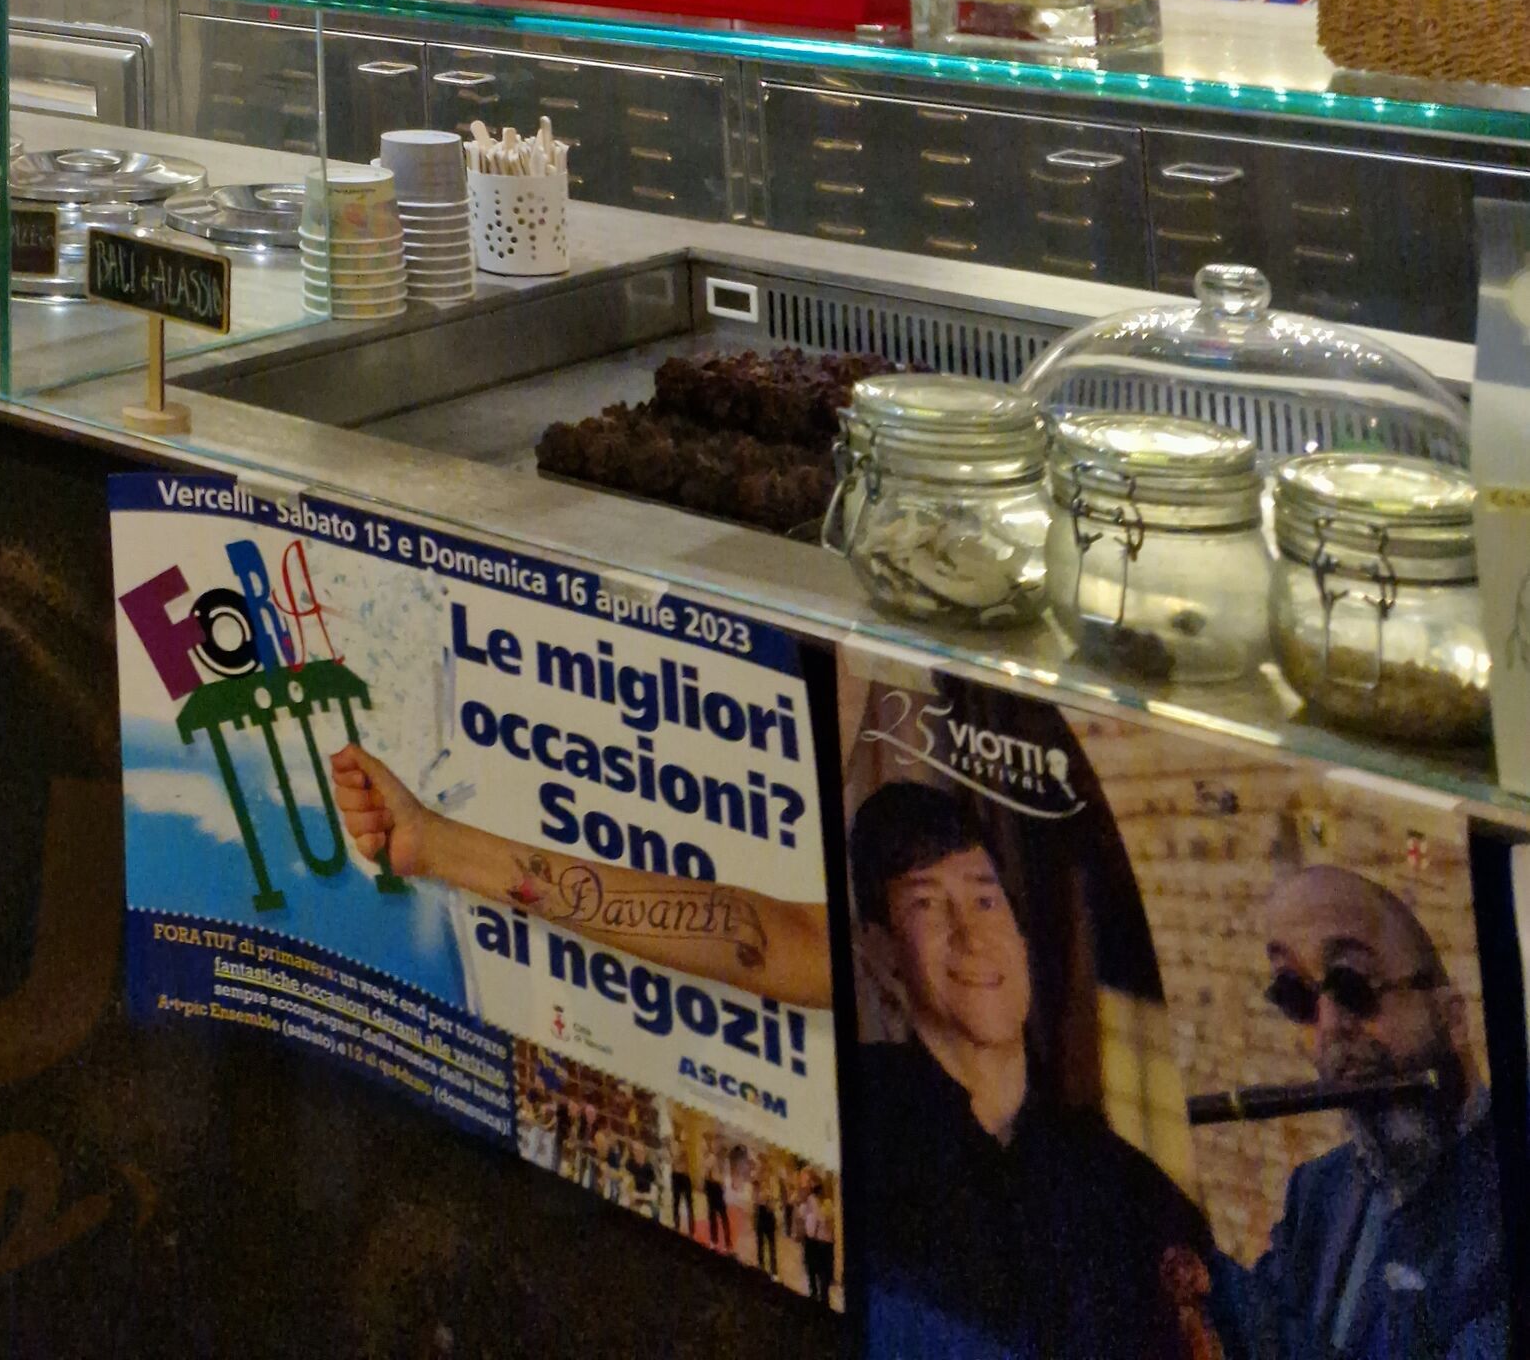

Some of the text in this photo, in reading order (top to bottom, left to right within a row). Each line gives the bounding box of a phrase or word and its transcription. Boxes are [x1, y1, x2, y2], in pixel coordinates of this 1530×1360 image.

[157, 479, 754, 655] Vercelli Sabato 15 e Domenica 16 aprile 2023
[449, 603, 799, 763] Le migliori
[459, 696, 806, 849] occasioni?
[946, 718, 1046, 776] VIOTTI
[537, 783, 717, 884] Sono
[558, 865, 734, 935] Davanti
[153, 923, 203, 947] FORA
[203, 930, 236, 952] TUT
[239, 938, 256, 957] di
[338, 972, 358, 991] un
[360, 976, 399, 1008] week
[400, 993, 427, 1022] end
[214, 956, 300, 994] fantastiche
[547, 930, 808, 1077] negozi!
[678, 1056, 788, 1119] ASCOM
